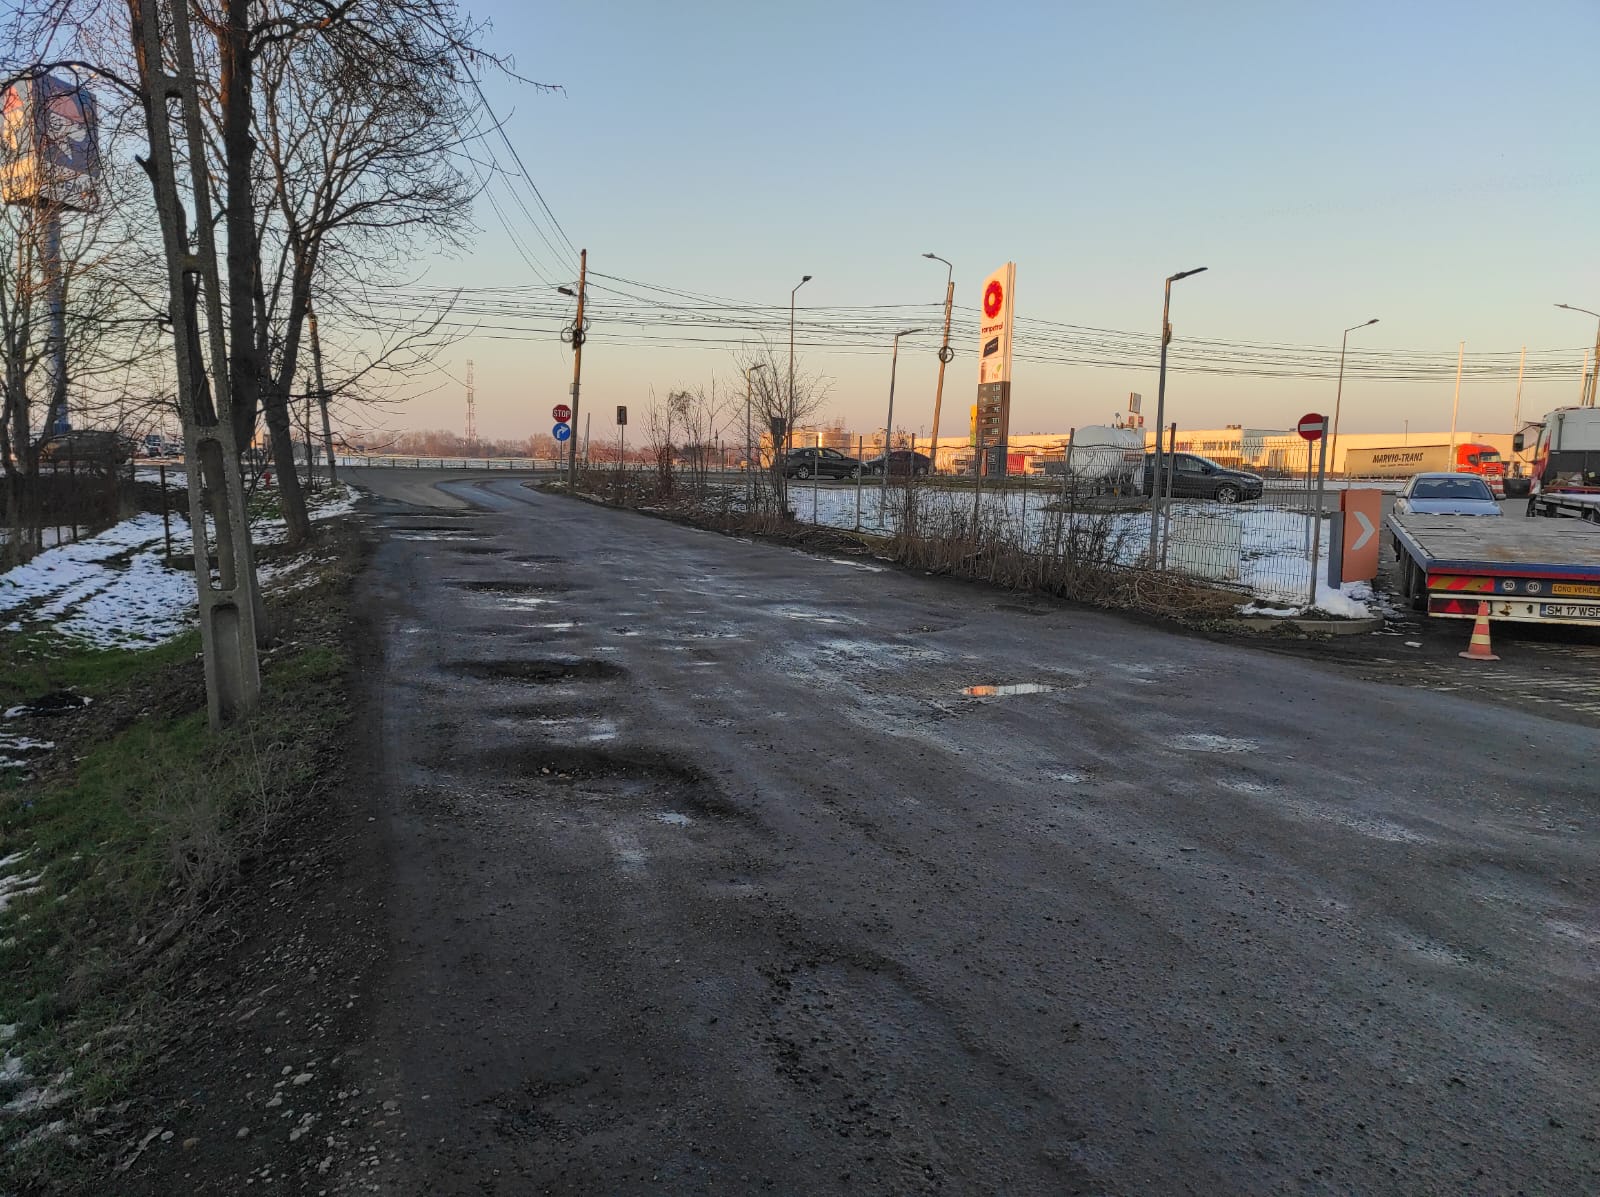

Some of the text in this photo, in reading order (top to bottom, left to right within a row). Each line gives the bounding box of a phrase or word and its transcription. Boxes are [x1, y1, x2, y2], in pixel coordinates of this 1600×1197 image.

[553, 410, 570, 418] STOP
[1553, 585, 1572, 593] LONG
[1547, 605, 1562, 615] SM
[1566, 606, 1577, 616] 17
